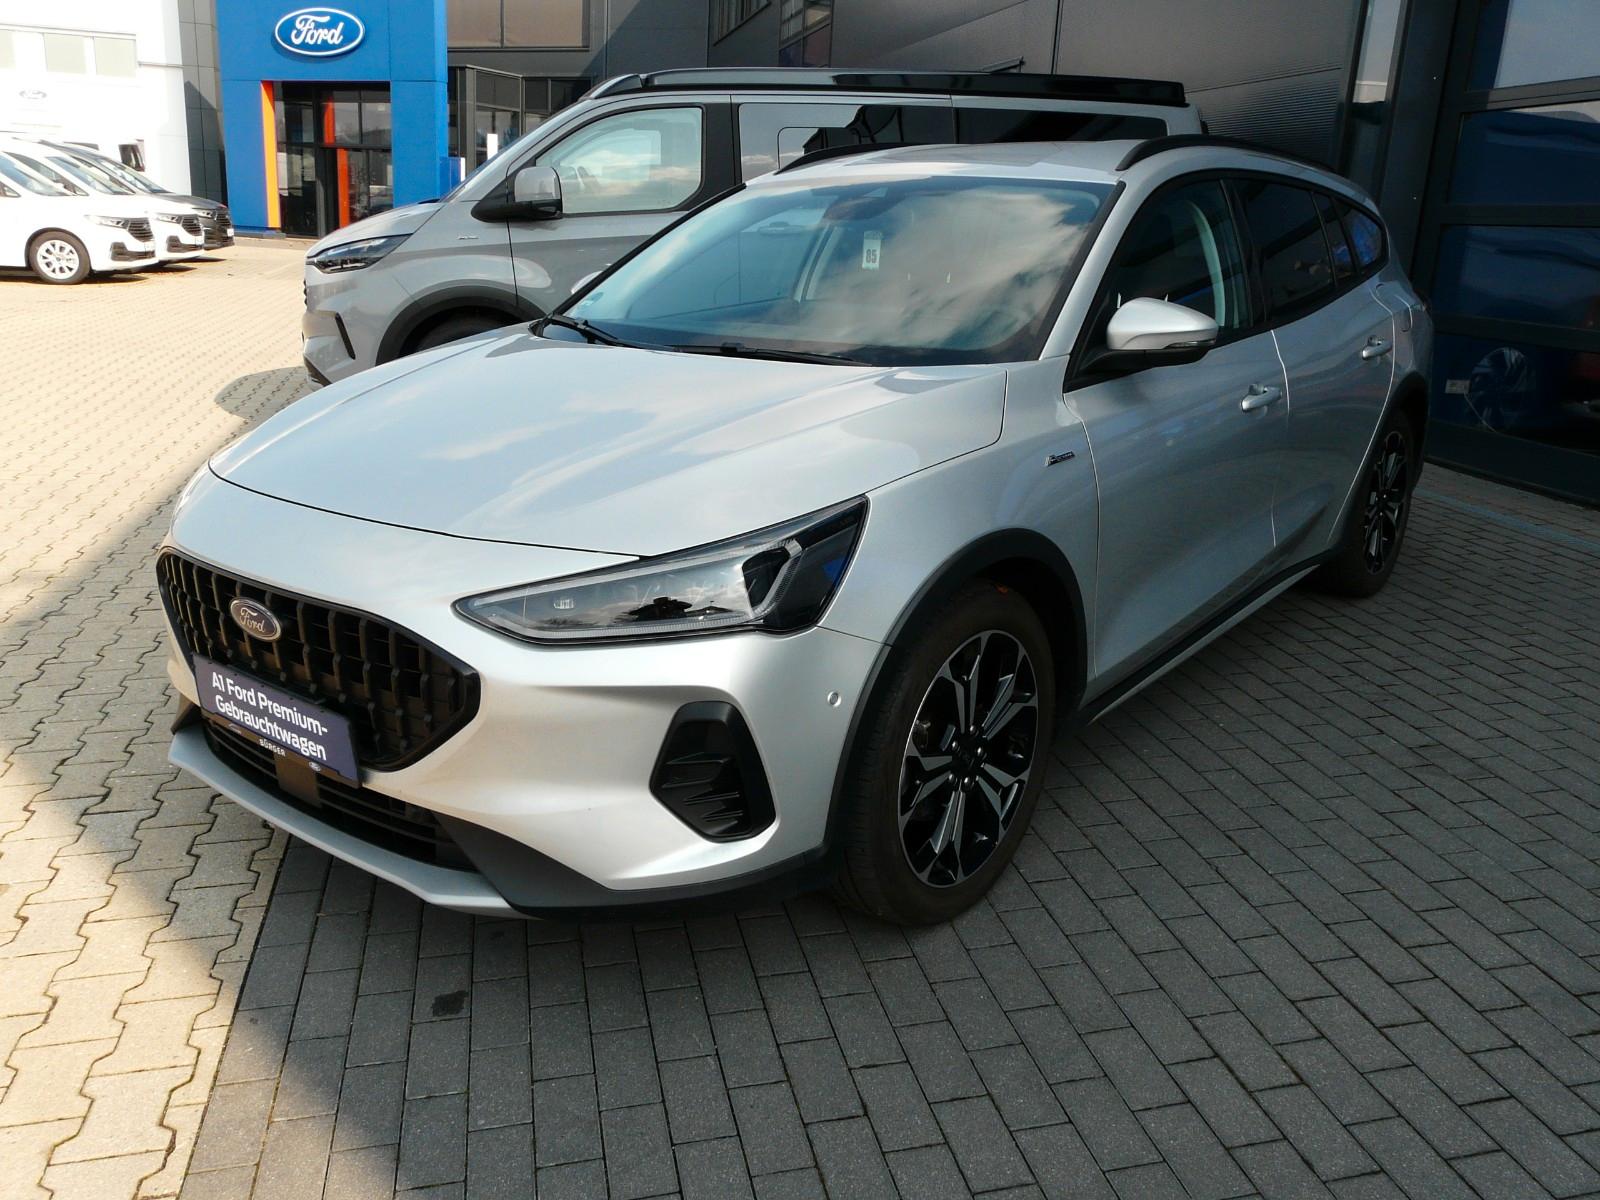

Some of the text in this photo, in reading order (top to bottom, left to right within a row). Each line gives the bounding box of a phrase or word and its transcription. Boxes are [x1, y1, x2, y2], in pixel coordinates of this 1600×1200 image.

[291, 14, 344, 45] Ford
[240, 607, 266, 633] Ford
[215, 694, 327, 761] Gebrauchtwagen
[226, 677, 257, 707] Ford
[257, 691, 328, 736] Premium-
